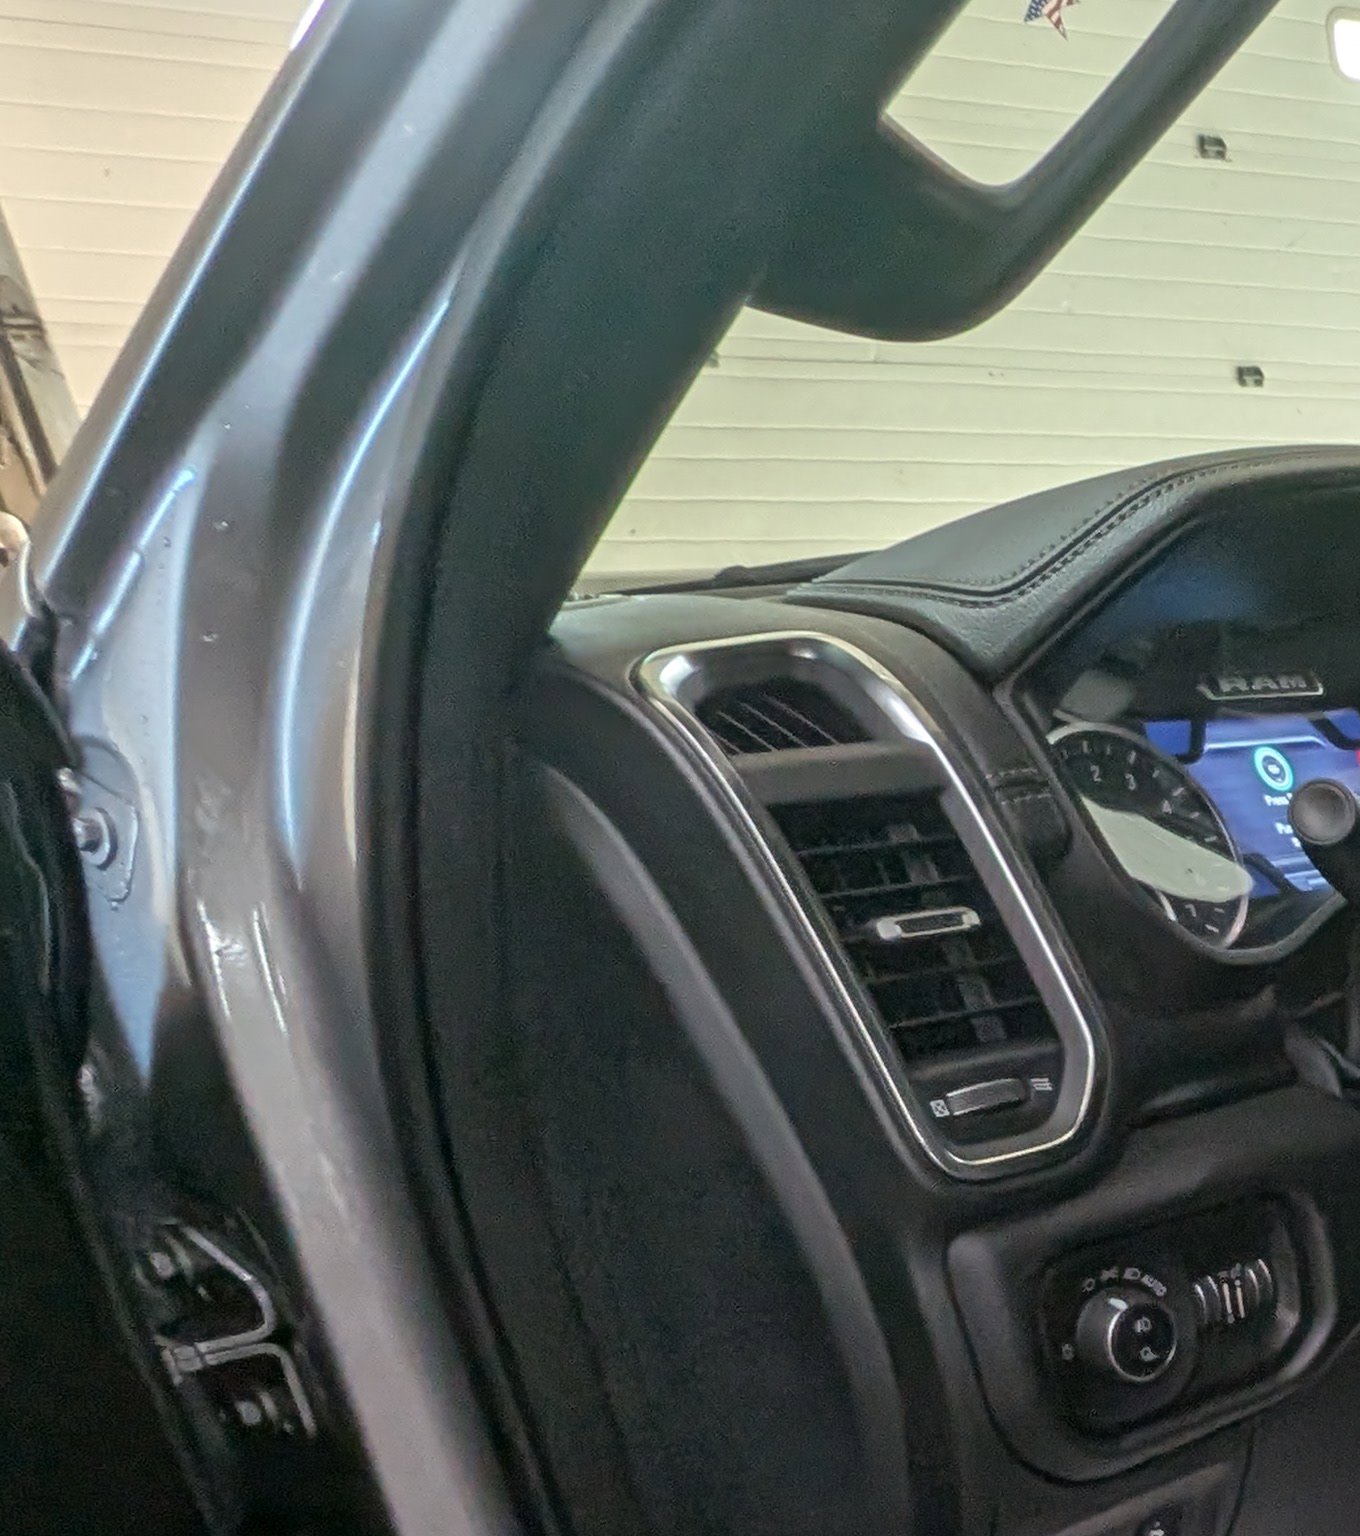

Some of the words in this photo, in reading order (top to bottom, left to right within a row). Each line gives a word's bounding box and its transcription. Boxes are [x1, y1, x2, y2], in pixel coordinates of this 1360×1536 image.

[1090, 765, 1101, 782] 2
[1125, 773, 1137, 791] 3
[1162, 800, 1172, 815] 4
